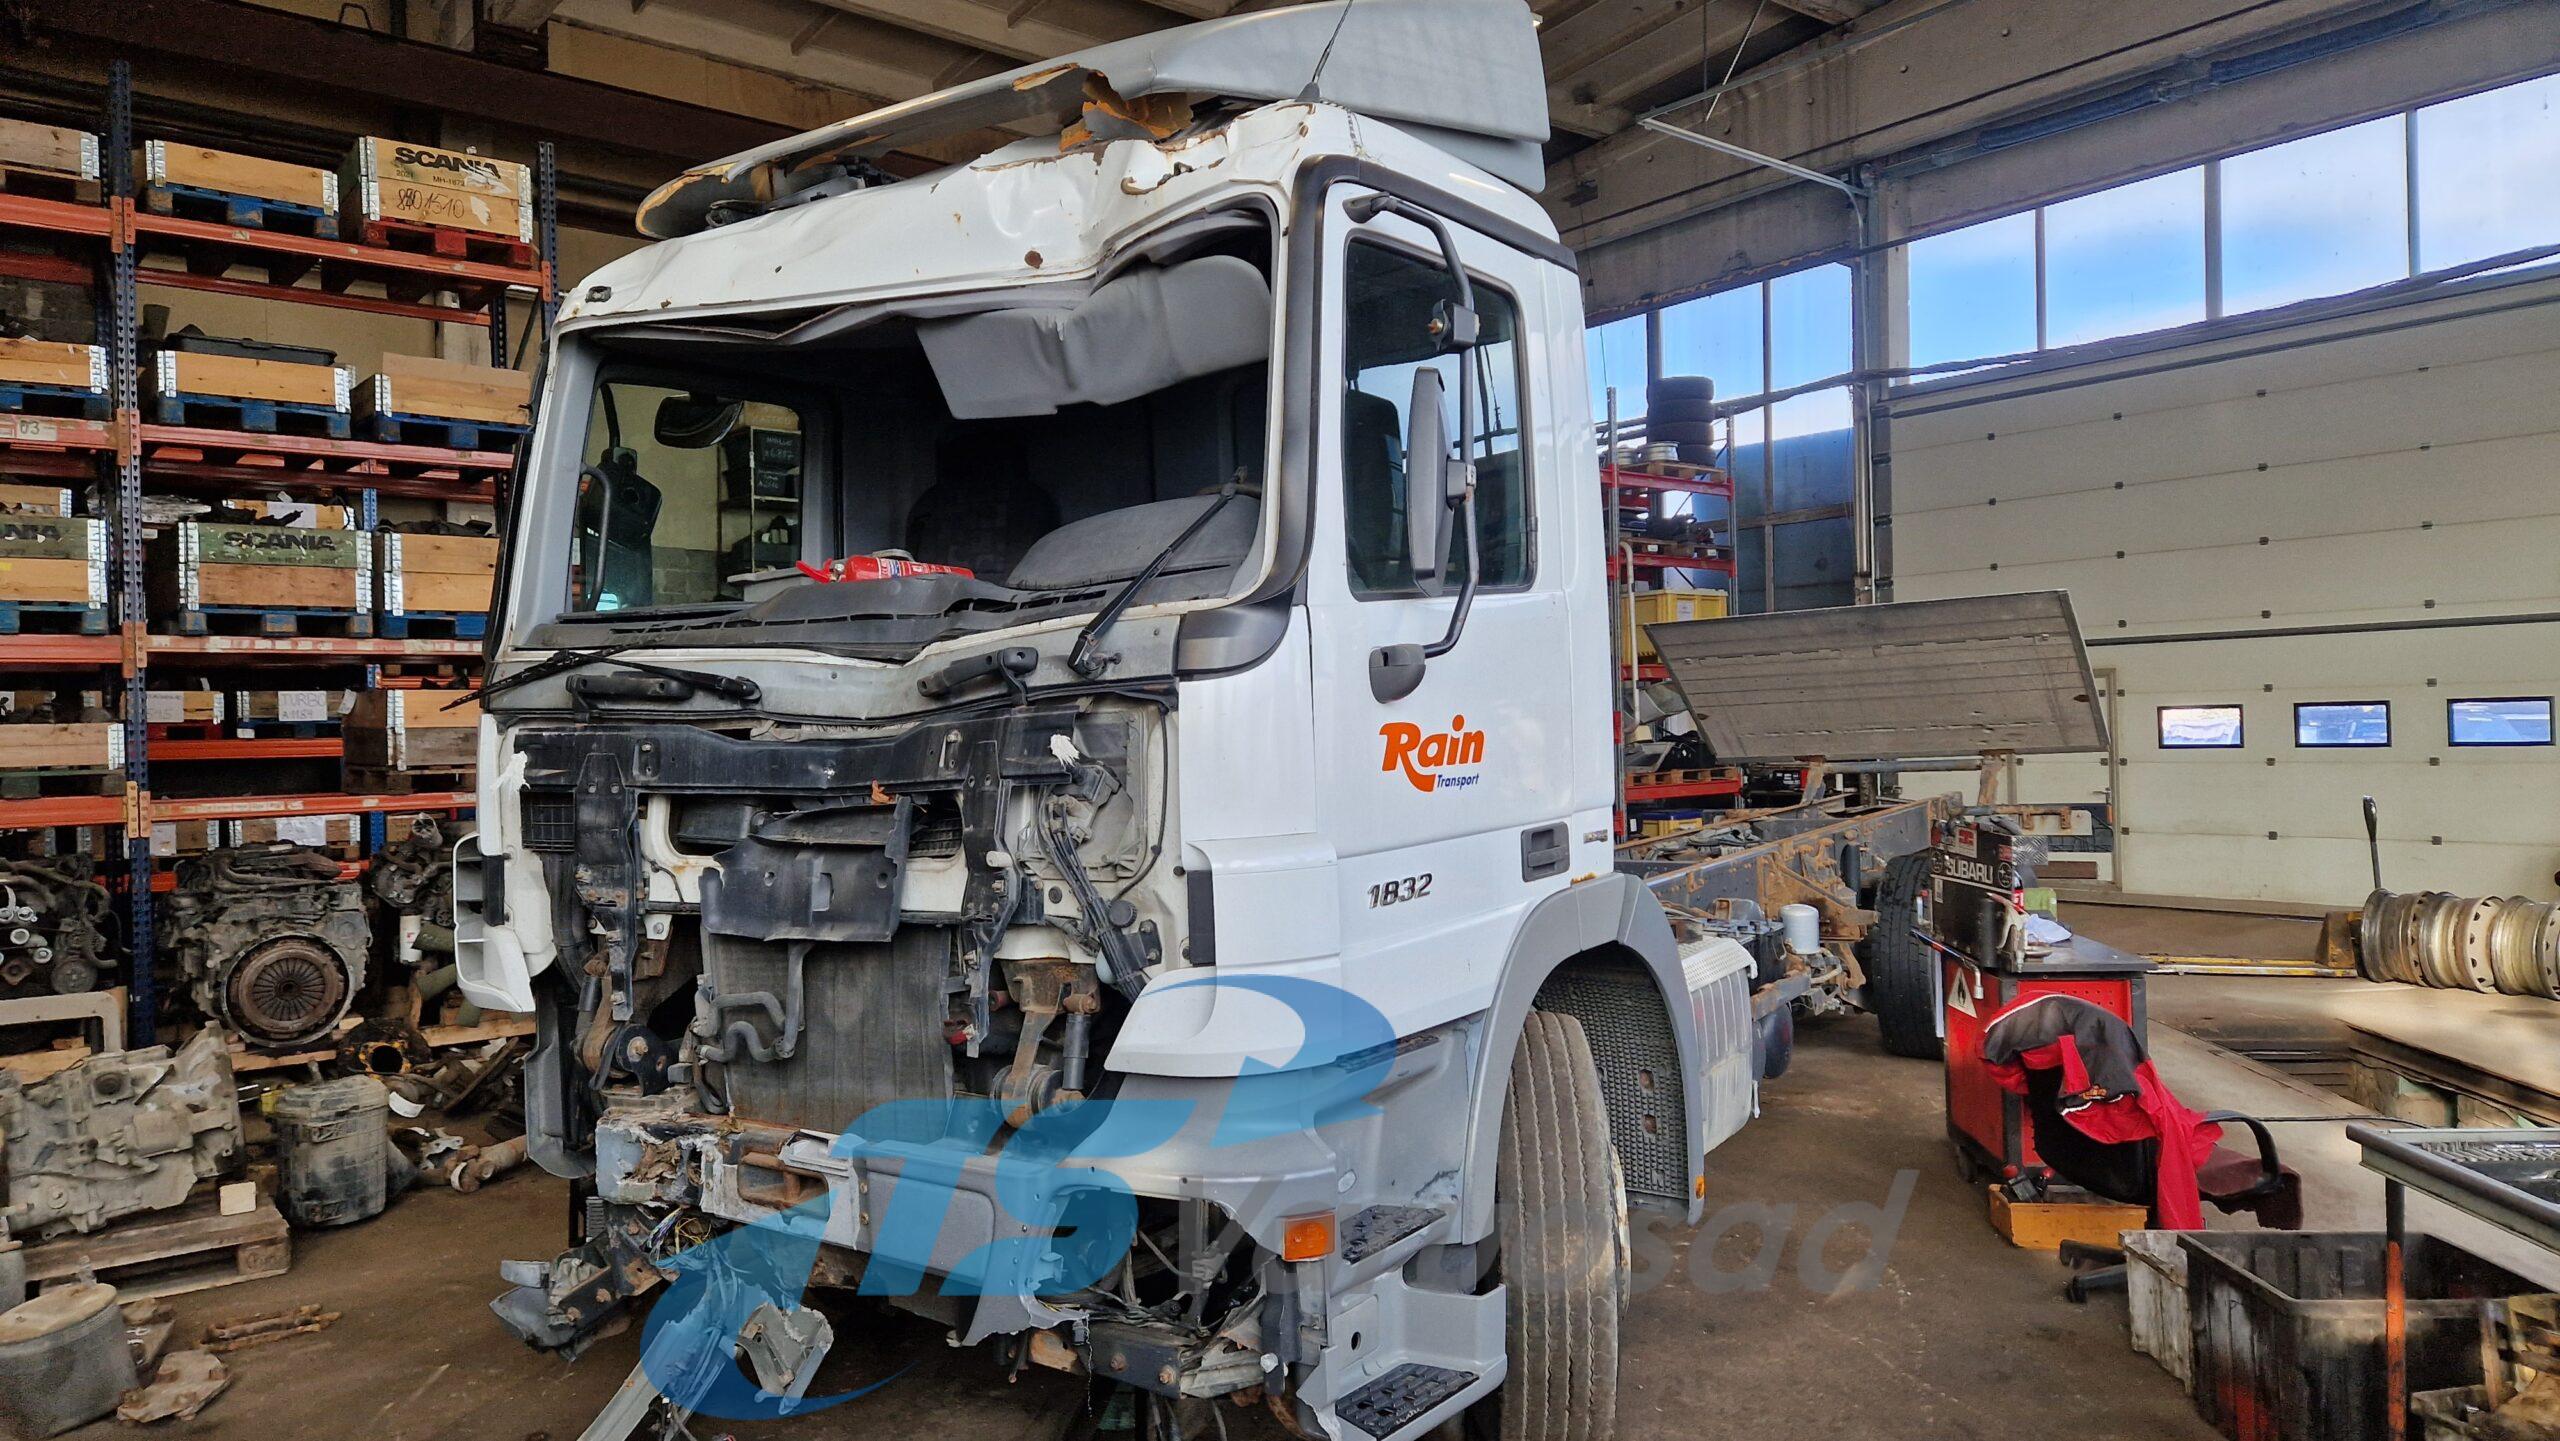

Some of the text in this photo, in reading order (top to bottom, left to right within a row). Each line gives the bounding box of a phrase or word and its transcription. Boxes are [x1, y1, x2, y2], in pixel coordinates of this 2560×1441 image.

[395, 146, 501, 179] SCANIA
[224, 531, 336, 551] SCANIA
[1379, 714, 1485, 792] Rain
[1437, 773, 1480, 790] Transport
[1945, 858, 1994, 884] SUBARU
[1367, 873, 1433, 909] 1832
